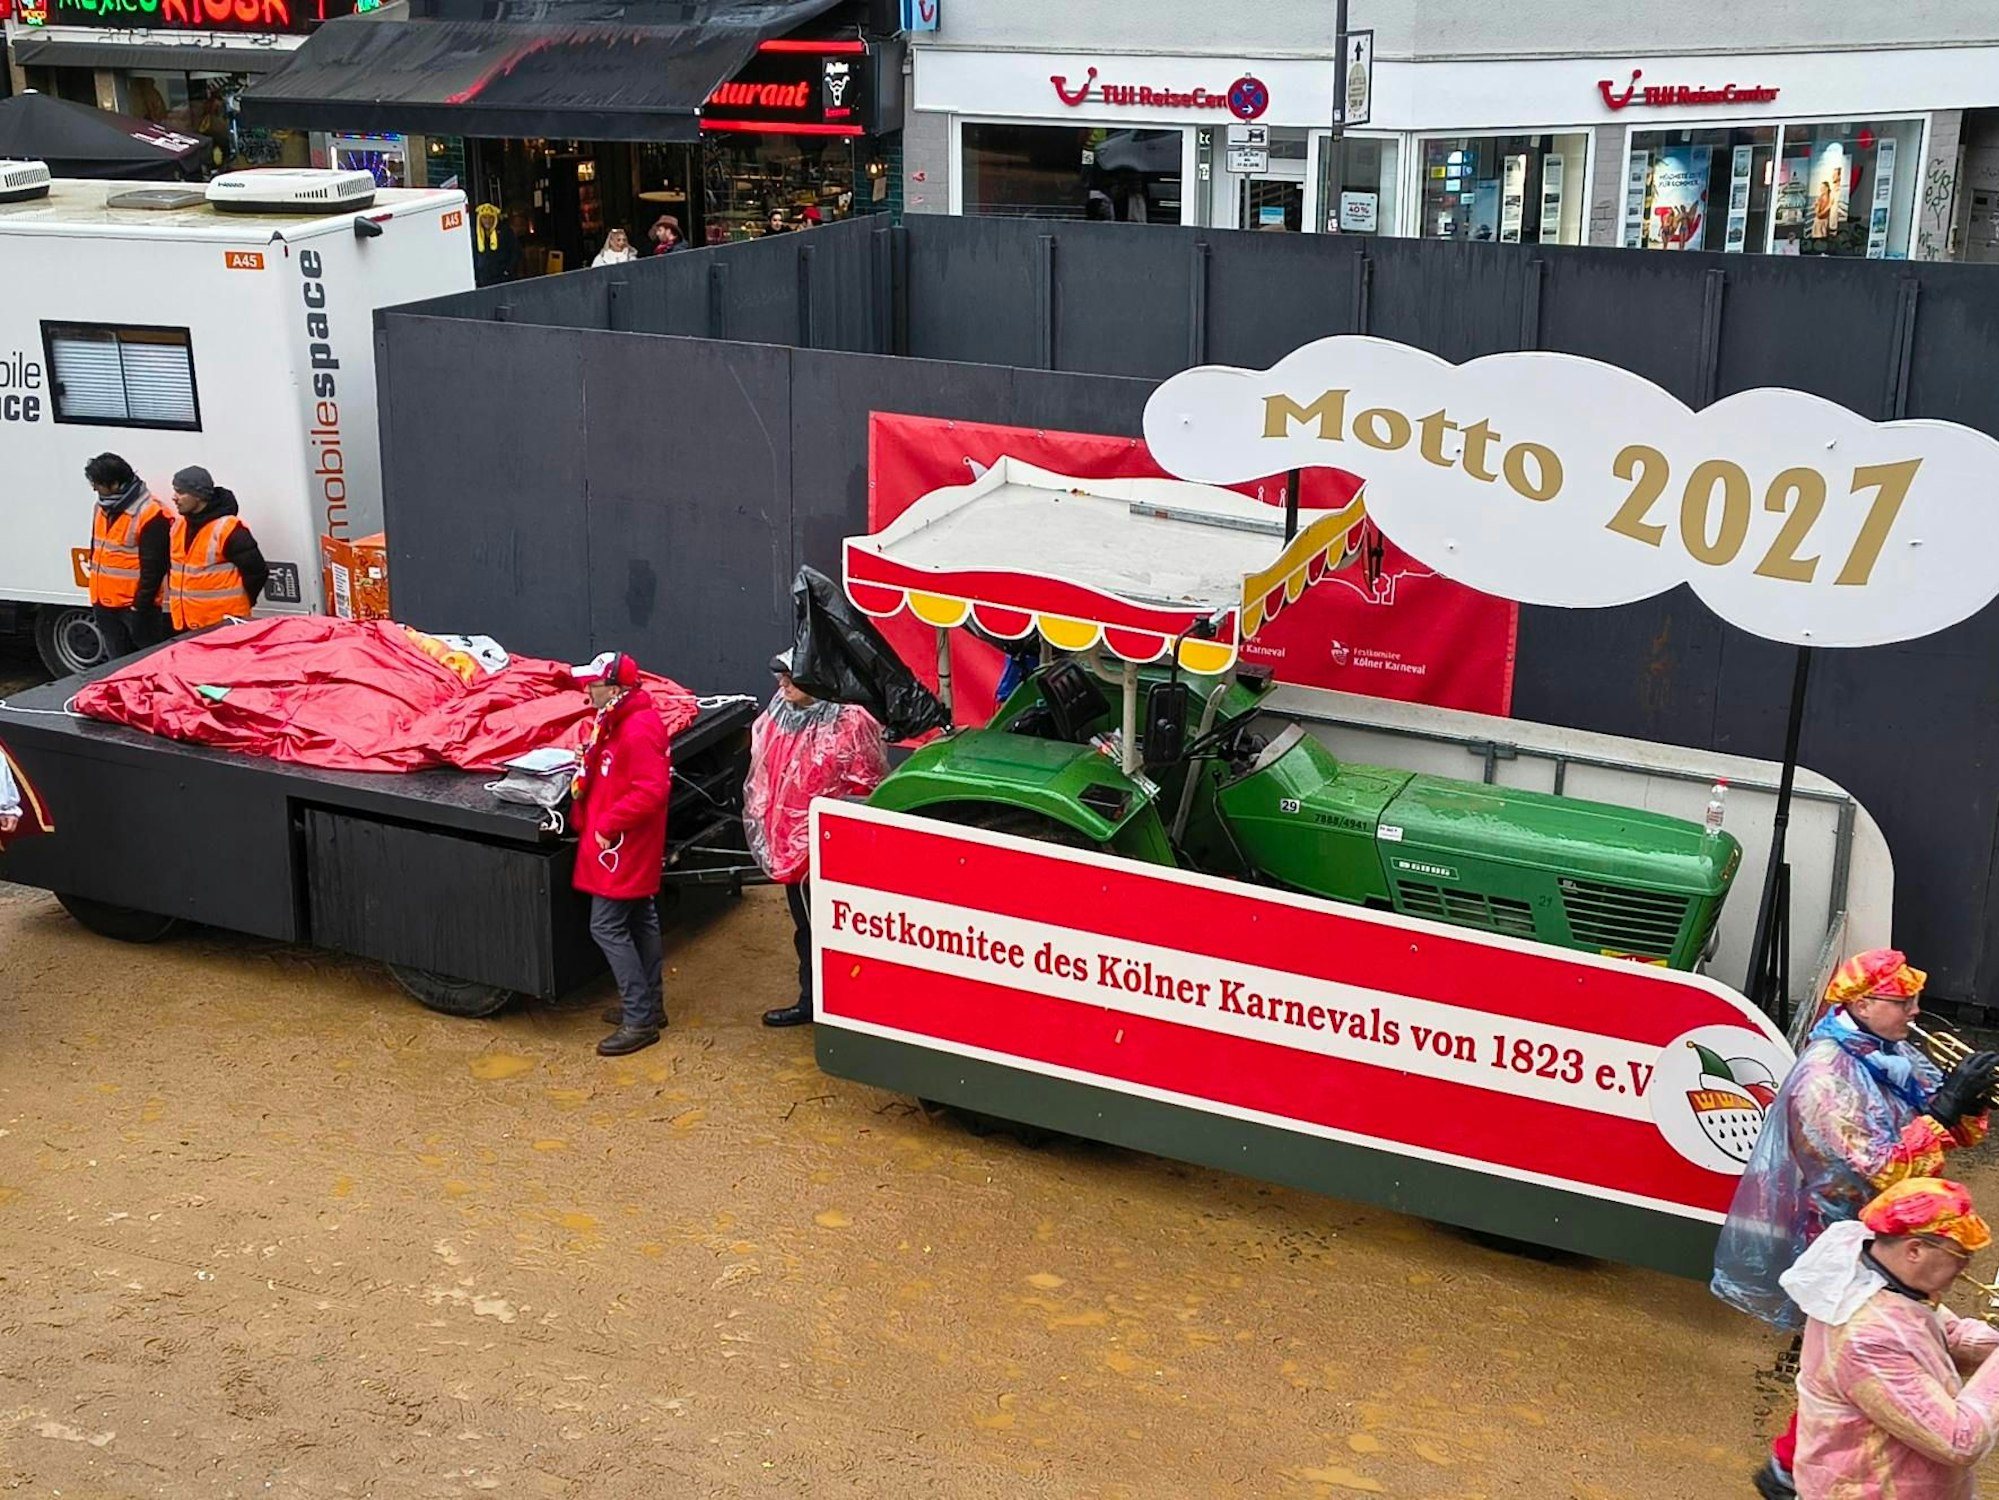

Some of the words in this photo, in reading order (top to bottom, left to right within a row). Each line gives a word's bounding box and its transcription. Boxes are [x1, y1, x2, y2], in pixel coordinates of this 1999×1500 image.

[1101, 85, 1134, 105] TUI
[444, 212, 460, 228] A45
[232, 253, 258, 268] A45
[300, 249, 350, 543] mobilespace
[1261, 389, 1564, 501] Motto
[1605, 444, 1924, 585] 2027
[1246, 644, 1286, 658] Karneval
[1353, 647, 1401, 660] Festkomitee
[1353, 656, 1384, 669] Kölner
[1385, 661, 1427, 675] Karneval
[1281, 799, 1298, 812] 29
[831, 899, 1025, 968] Festkomitee
[1034, 942, 1089, 981] des
[1097, 954, 1211, 1007] Kölner
[1218, 978, 1400, 1046] Karnevals
[1410, 1025, 1477, 1063] von
[1490, 1035, 1584, 1084] 1823
